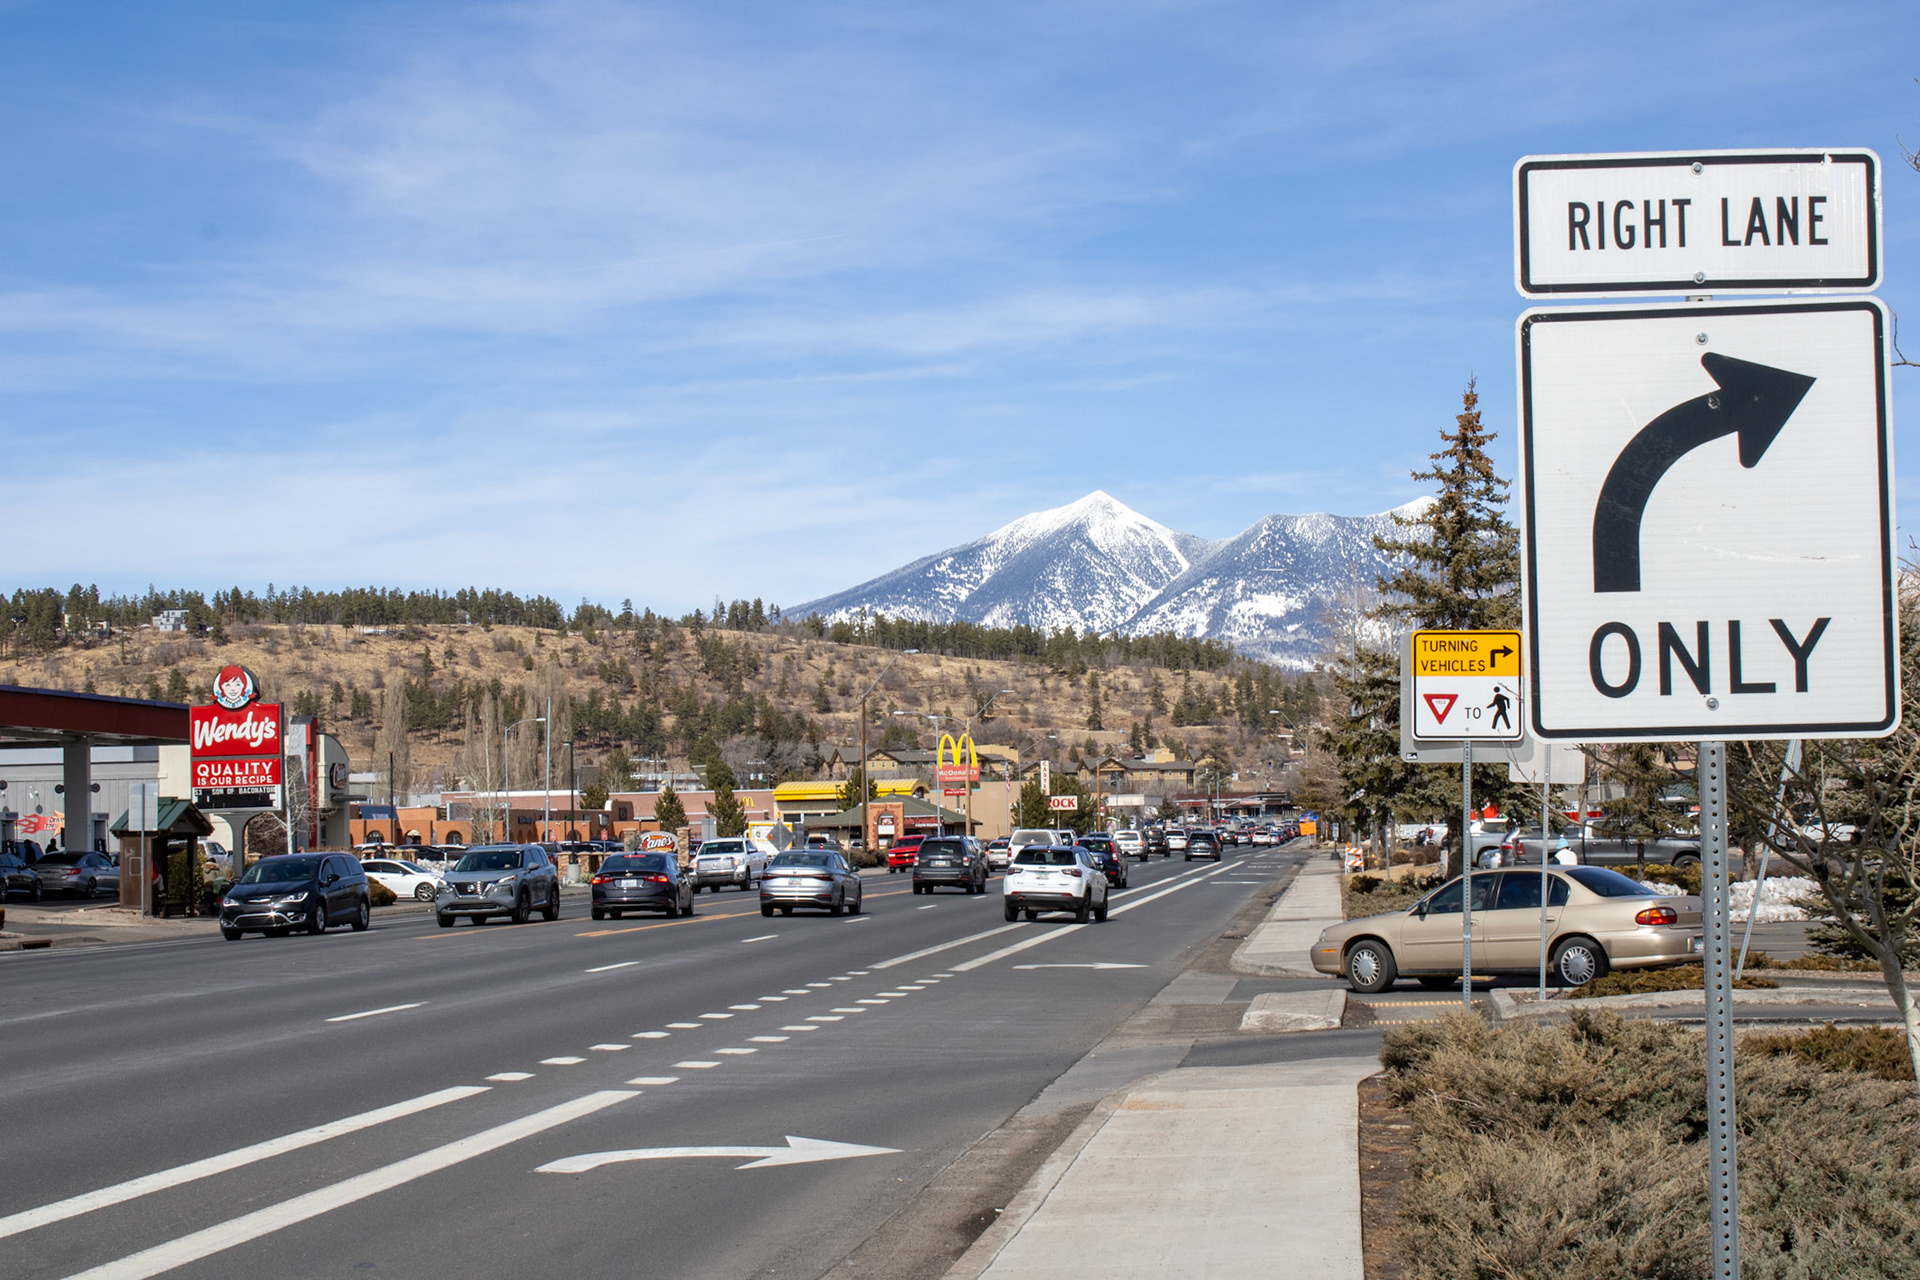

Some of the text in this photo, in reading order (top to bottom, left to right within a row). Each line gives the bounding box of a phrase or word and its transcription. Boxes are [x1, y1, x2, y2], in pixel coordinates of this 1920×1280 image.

[1569, 196, 1829, 251] RIGHT LANE
[1422, 640, 1478, 652] TURNING
[1589, 617, 1832, 698] ONLY
[1421, 660, 1486, 672] VEHICLES
[1464, 707, 1481, 719] TO
[194, 711, 276, 750] Wendy's
[197, 762, 273, 777] QUALITY
[197, 775, 273, 786] IS OUR RECIPE
[239, 787, 276, 795] BACONATOR
